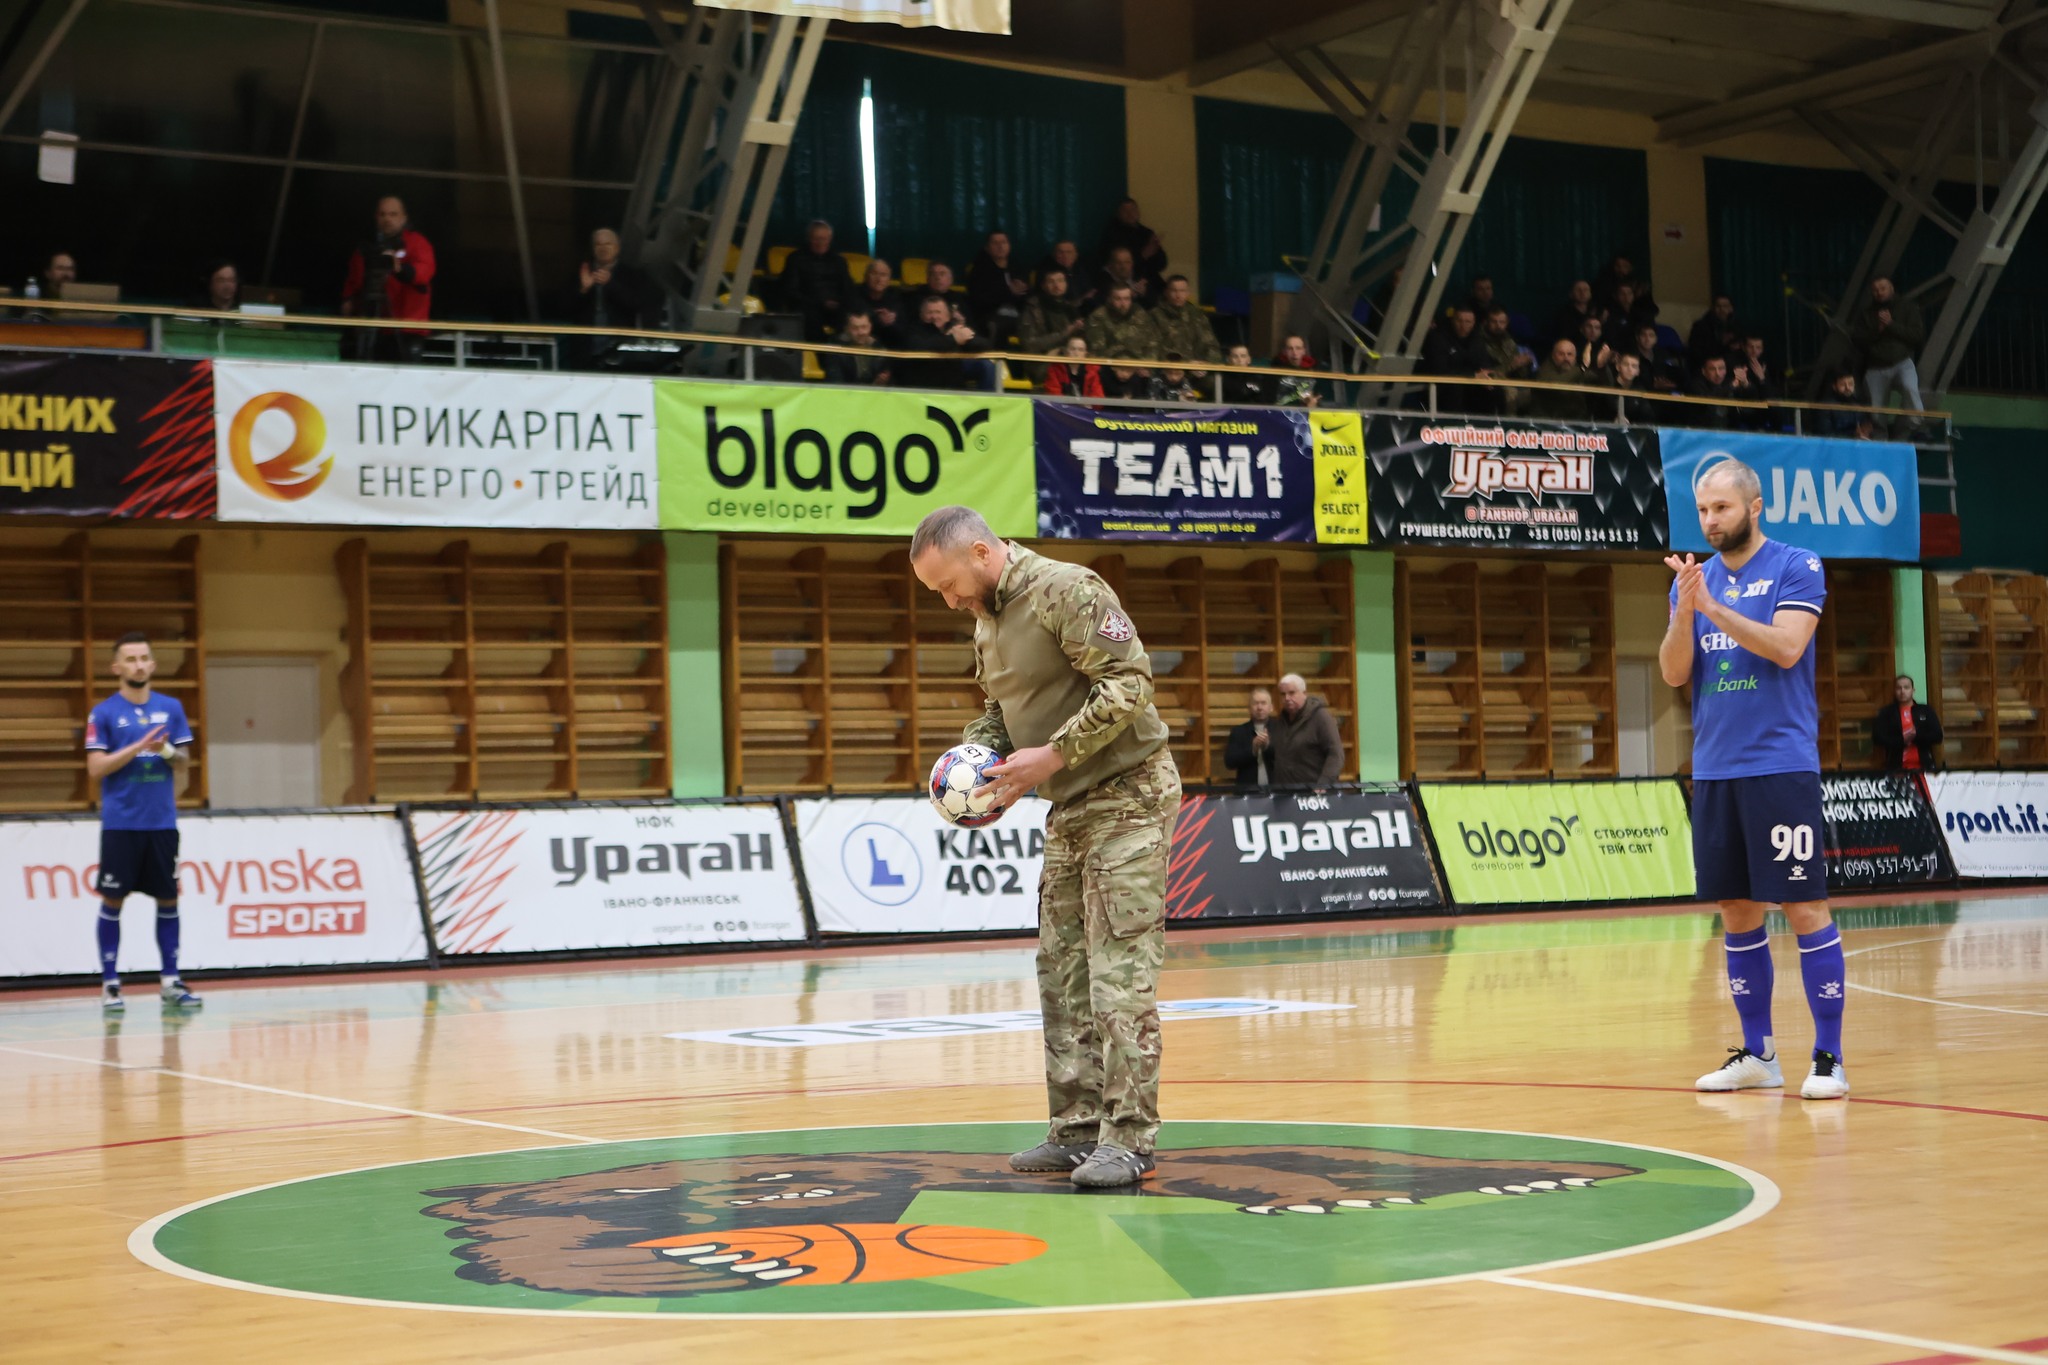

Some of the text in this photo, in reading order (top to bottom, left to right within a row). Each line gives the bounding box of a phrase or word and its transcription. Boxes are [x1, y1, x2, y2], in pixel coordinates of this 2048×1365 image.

[357, 404, 645, 452] ПРИКАРПАТ
[1420, 426, 1609, 452] ОФІЦІЙНИЙ ФАН-ШОП НФК
[704, 406, 941, 519] blago
[1069, 439, 1284, 499] TEAM1
[359, 464, 649, 510] ЕНЕРГО ТРЕЙД
[1765, 467, 1898, 527] JAKO
[707, 498, 833, 522] developer
[1321, 503, 1360, 515] SELECT
[1298, 796, 1330, 811] НФК
[1858, 799, 1917, 820] УРАГАН
[636, 816, 674, 829] НФК
[1594, 826, 1669, 840] СТВОРЮЄМО
[1457, 821, 1566, 869] blago
[1598, 842, 1654, 855] ТВІЙ СВІТ
[1771, 824, 1814, 861] 90
[1280, 865, 1389, 882] ІВАНО-ФРАНКІВСЬК
[1471, 861, 1525, 872] developer
[945, 864, 1024, 895] 402
[603, 894, 741, 910] ІВАНО-ФРАНКІВСЬК
[1320, 891, 1363, 904] uragan.if.ua
[233, 907, 362, 935] SPORT
